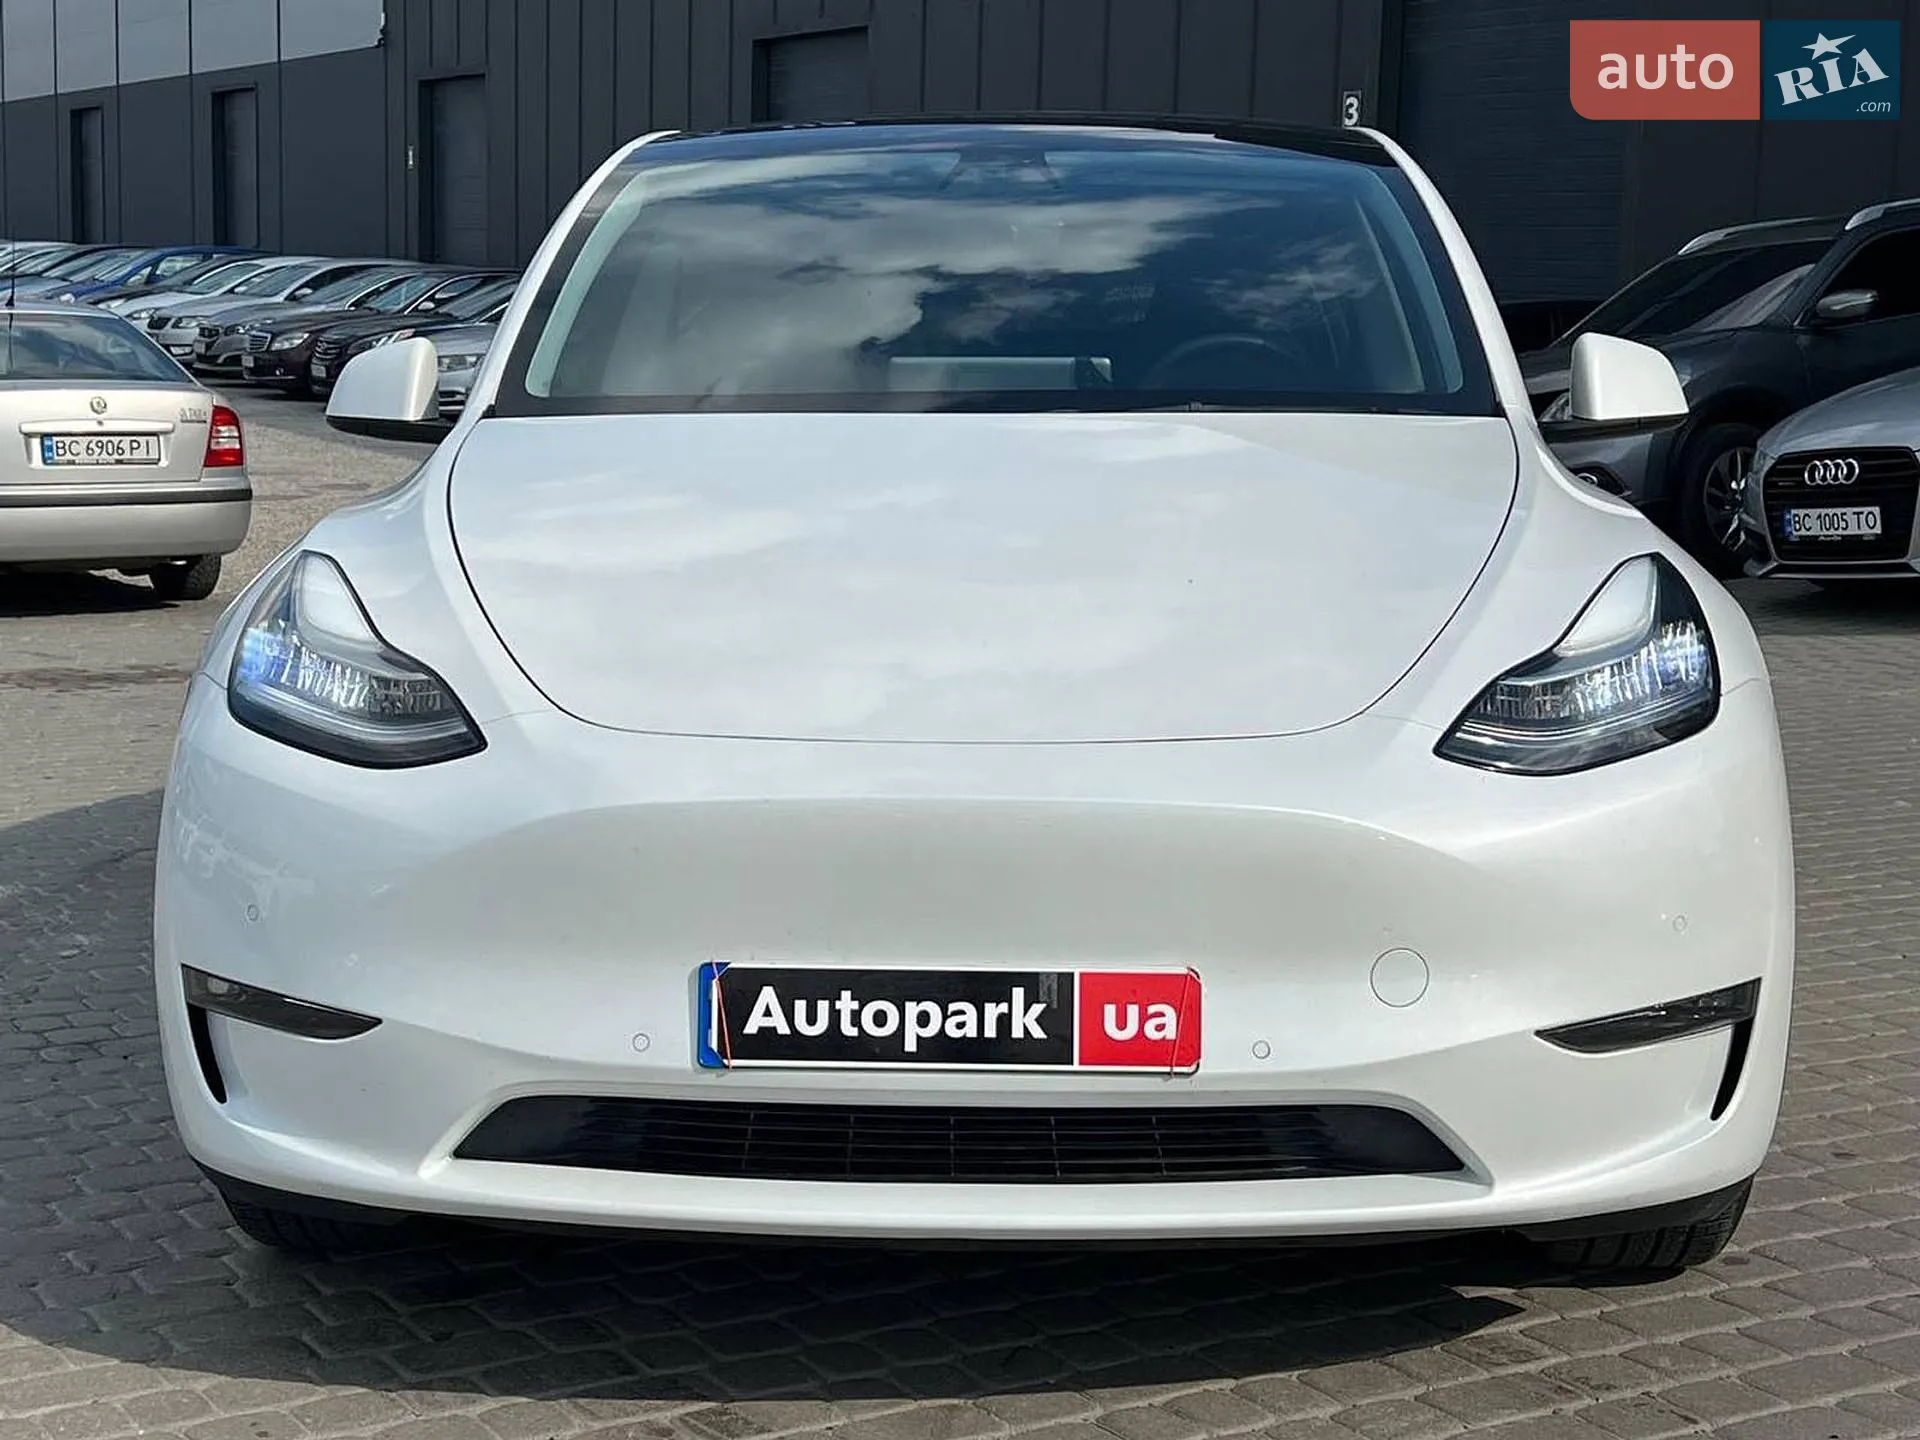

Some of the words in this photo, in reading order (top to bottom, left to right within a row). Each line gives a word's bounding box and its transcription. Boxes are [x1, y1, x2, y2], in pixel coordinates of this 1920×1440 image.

[1343, 96, 1359, 126] 3
[55, 441, 81, 456] BC
[85, 440, 126, 456] 6906
[129, 440, 150, 455] PI
[1793, 513, 1812, 532] BC
[1816, 512, 1849, 532] 1005
[1853, 511, 1877, 530] TO
[742, 985, 1048, 1052] Autopark
[1102, 1003, 1177, 1041] ua
